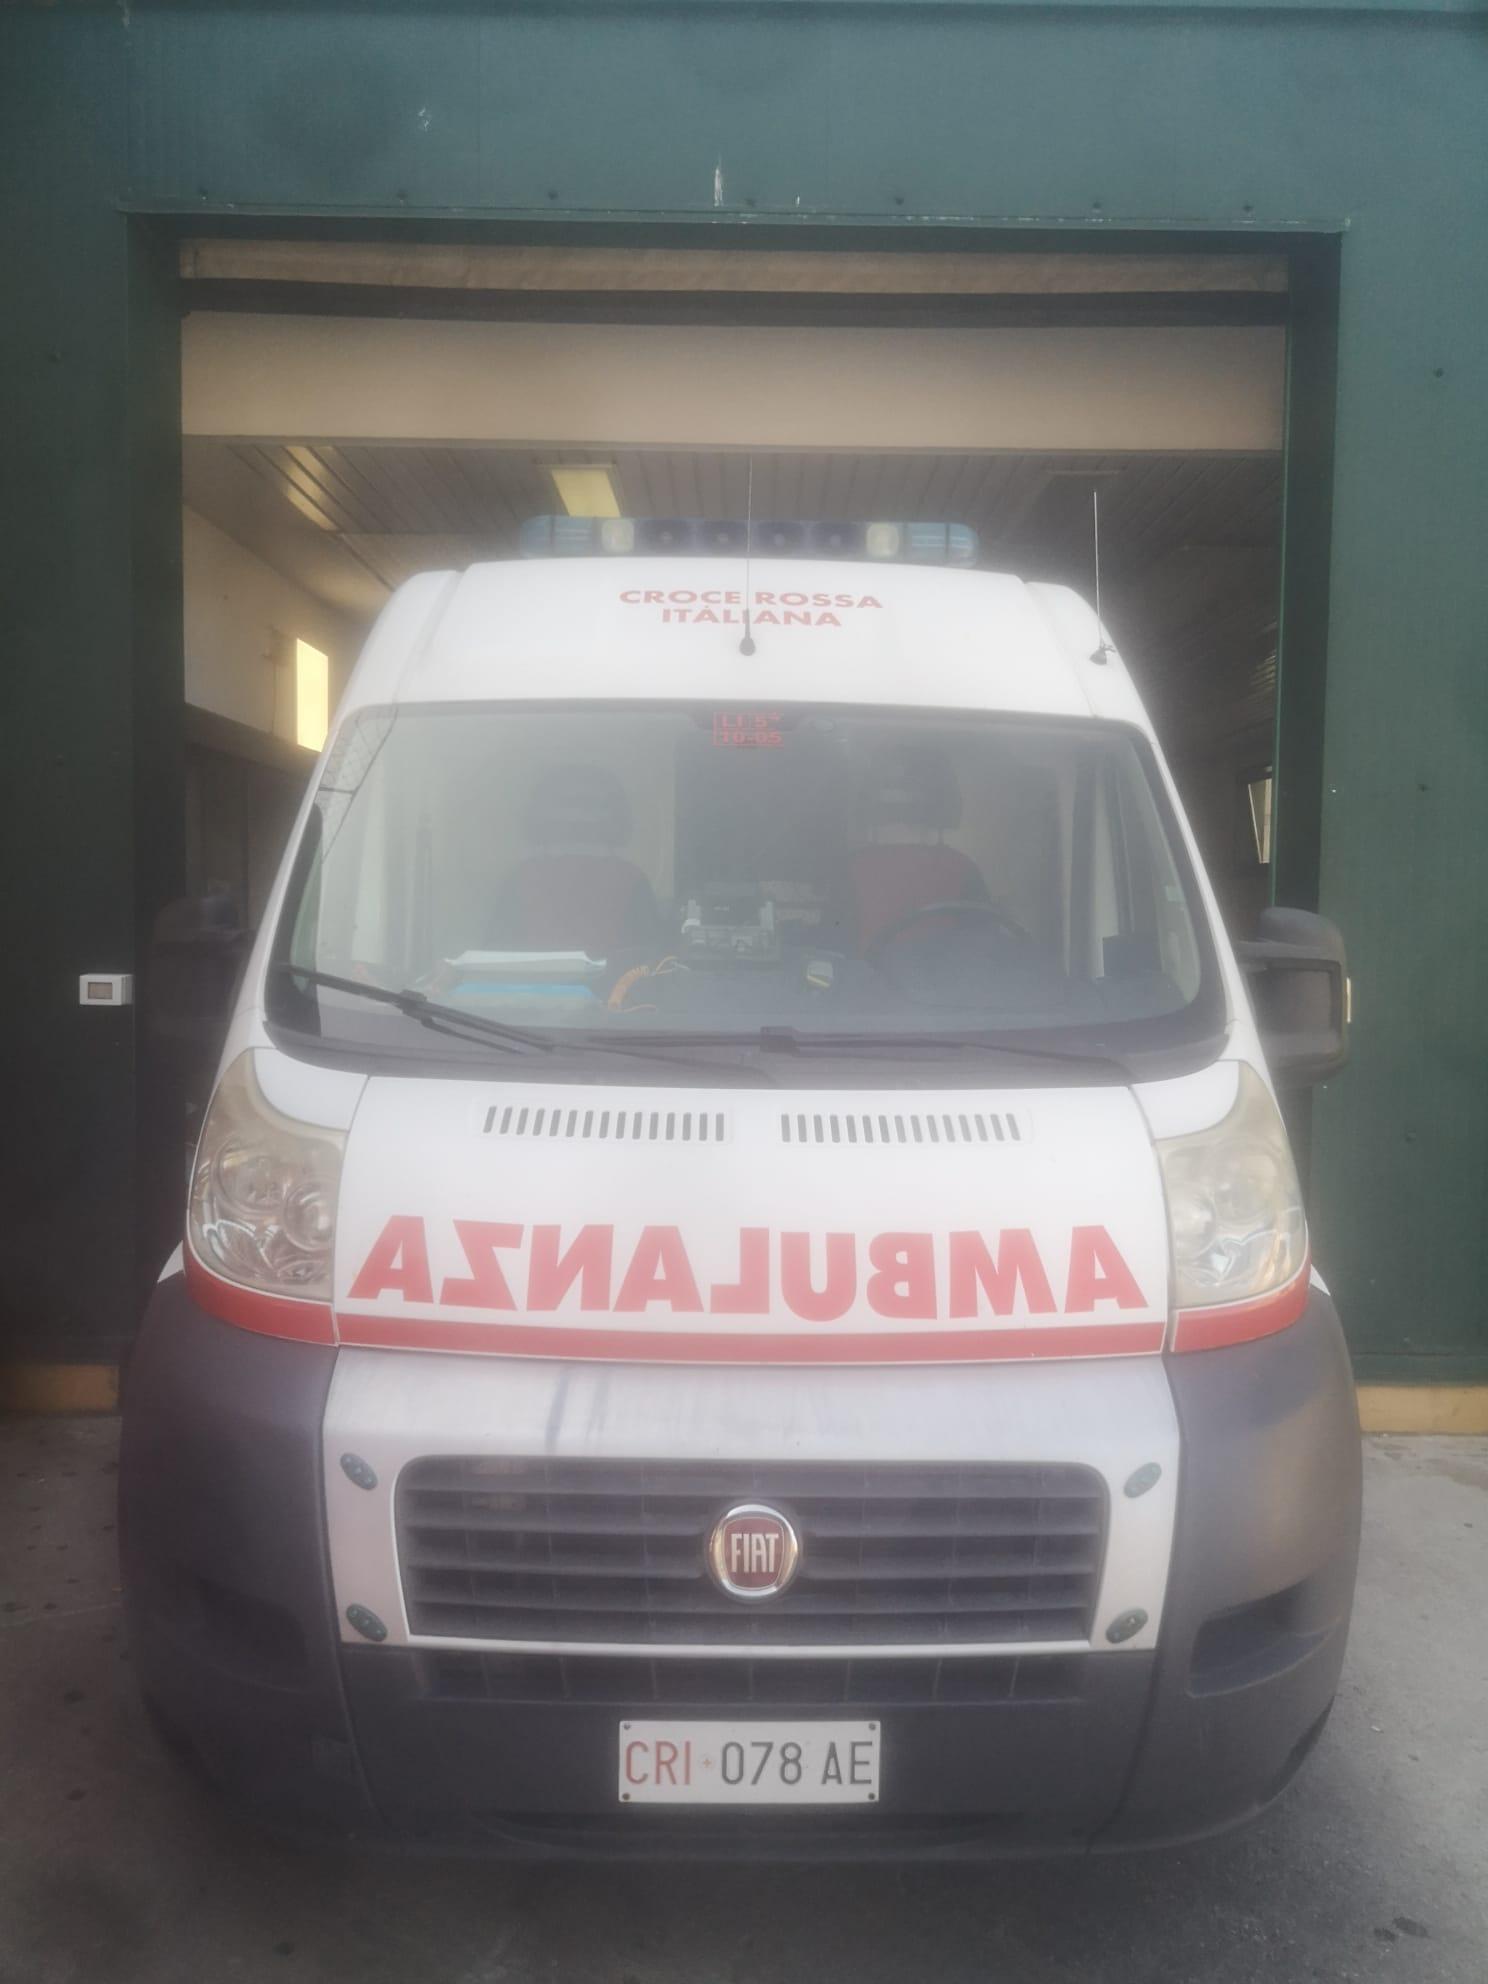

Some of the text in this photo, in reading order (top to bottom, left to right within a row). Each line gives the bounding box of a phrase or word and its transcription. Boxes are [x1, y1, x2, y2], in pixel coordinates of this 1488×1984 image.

[619, 590, 883, 609] CROCE ROSSA
[662, 608, 842, 626] ITALIANA
[731, 1533, 779, 1573] FIAT
[624, 1741, 873, 1785] CRI 078 AE
